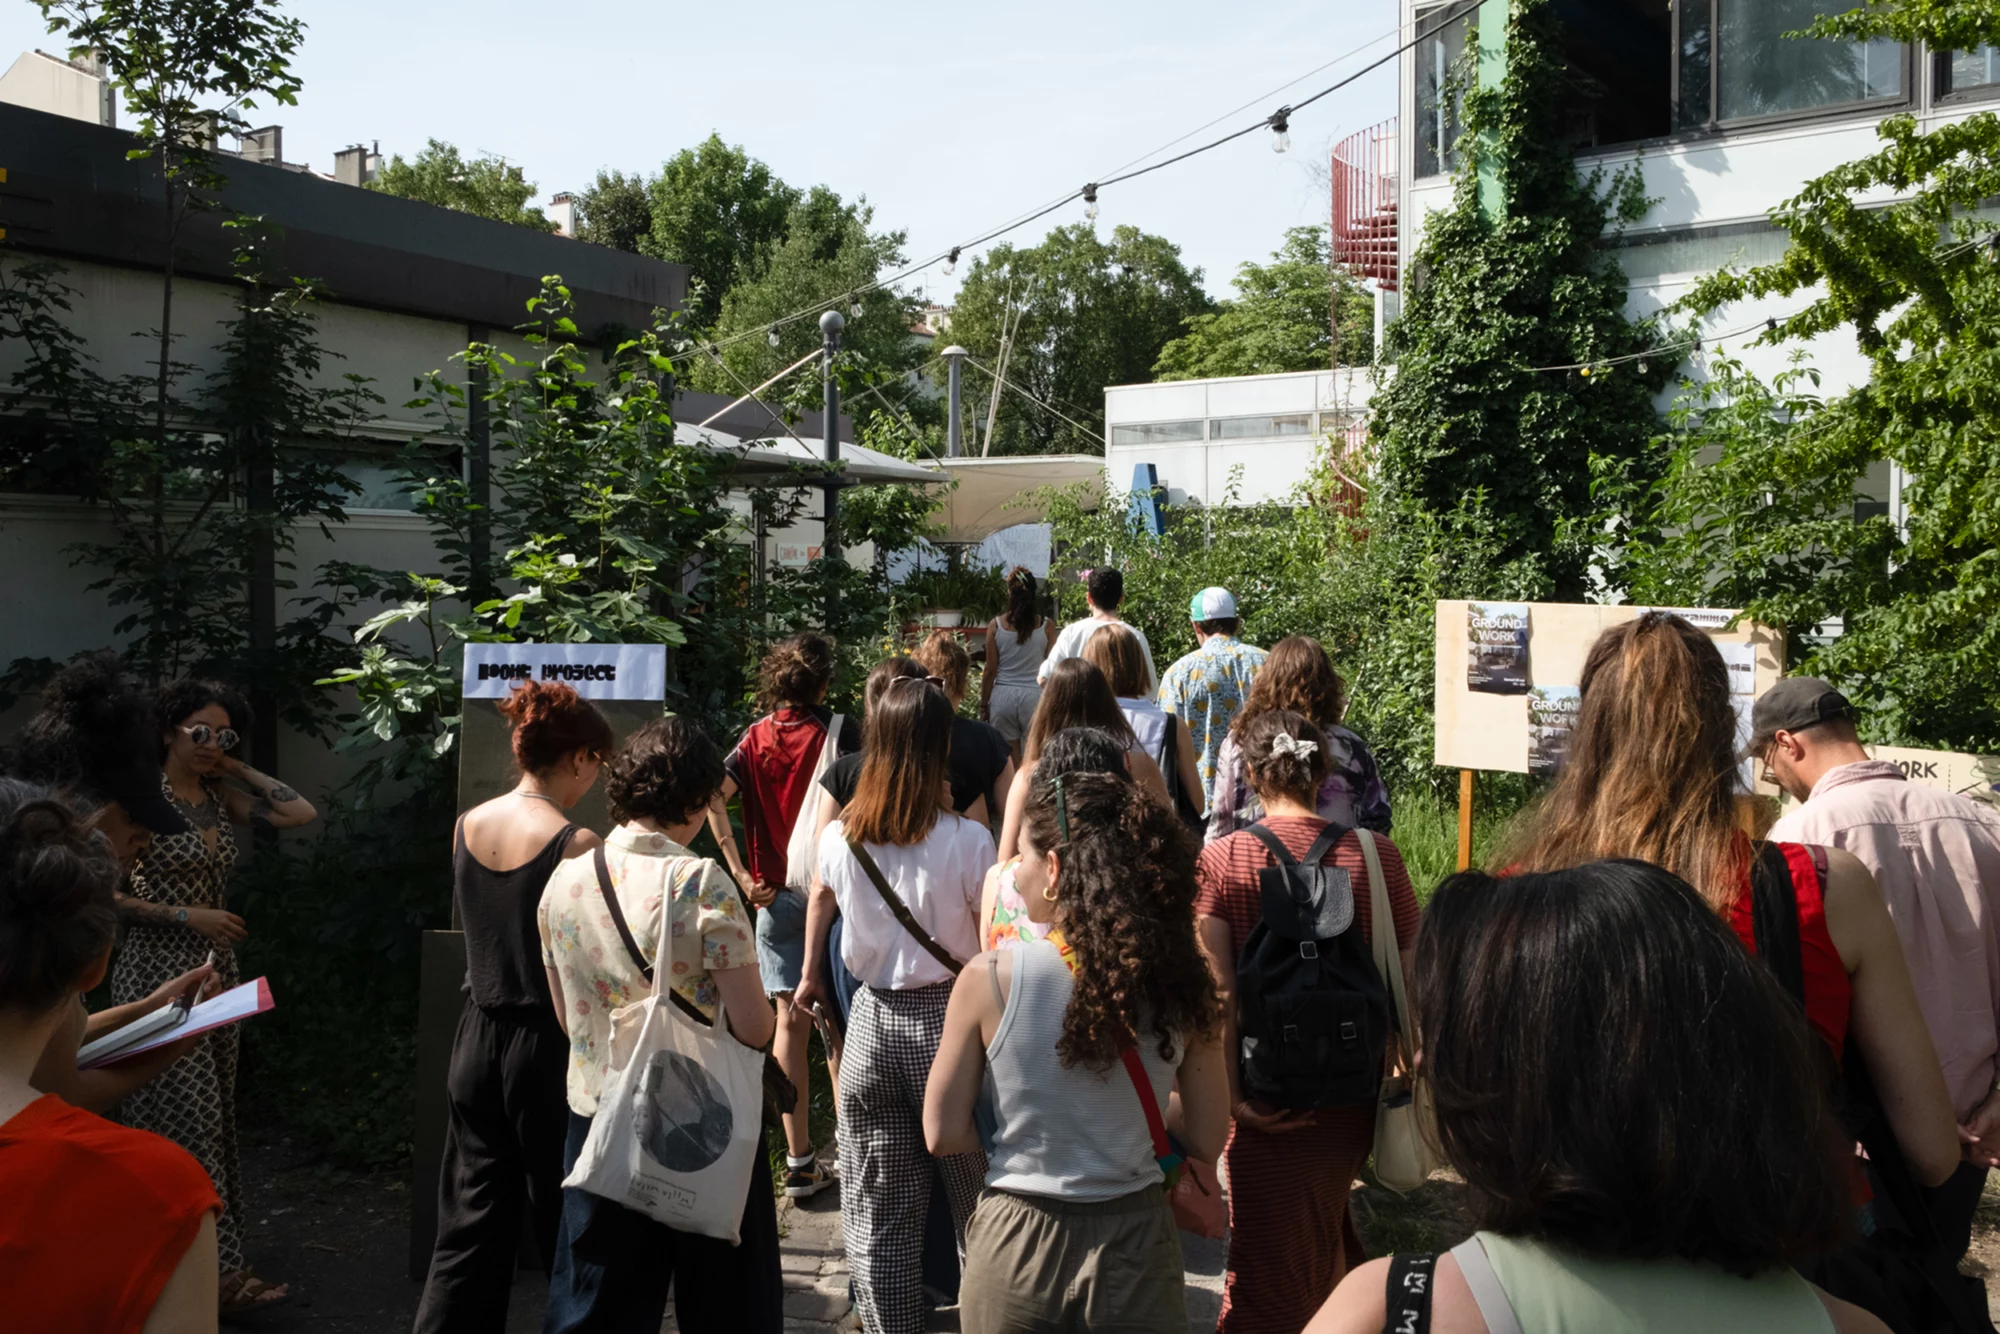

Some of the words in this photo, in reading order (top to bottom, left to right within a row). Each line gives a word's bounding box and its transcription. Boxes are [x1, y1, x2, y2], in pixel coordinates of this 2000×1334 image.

[1472, 618, 1523, 629] GROUND
[1479, 630, 1516, 641] WORK
[1532, 700, 1581, 712] GROUN
[1894, 759, 1938, 779] ORK
